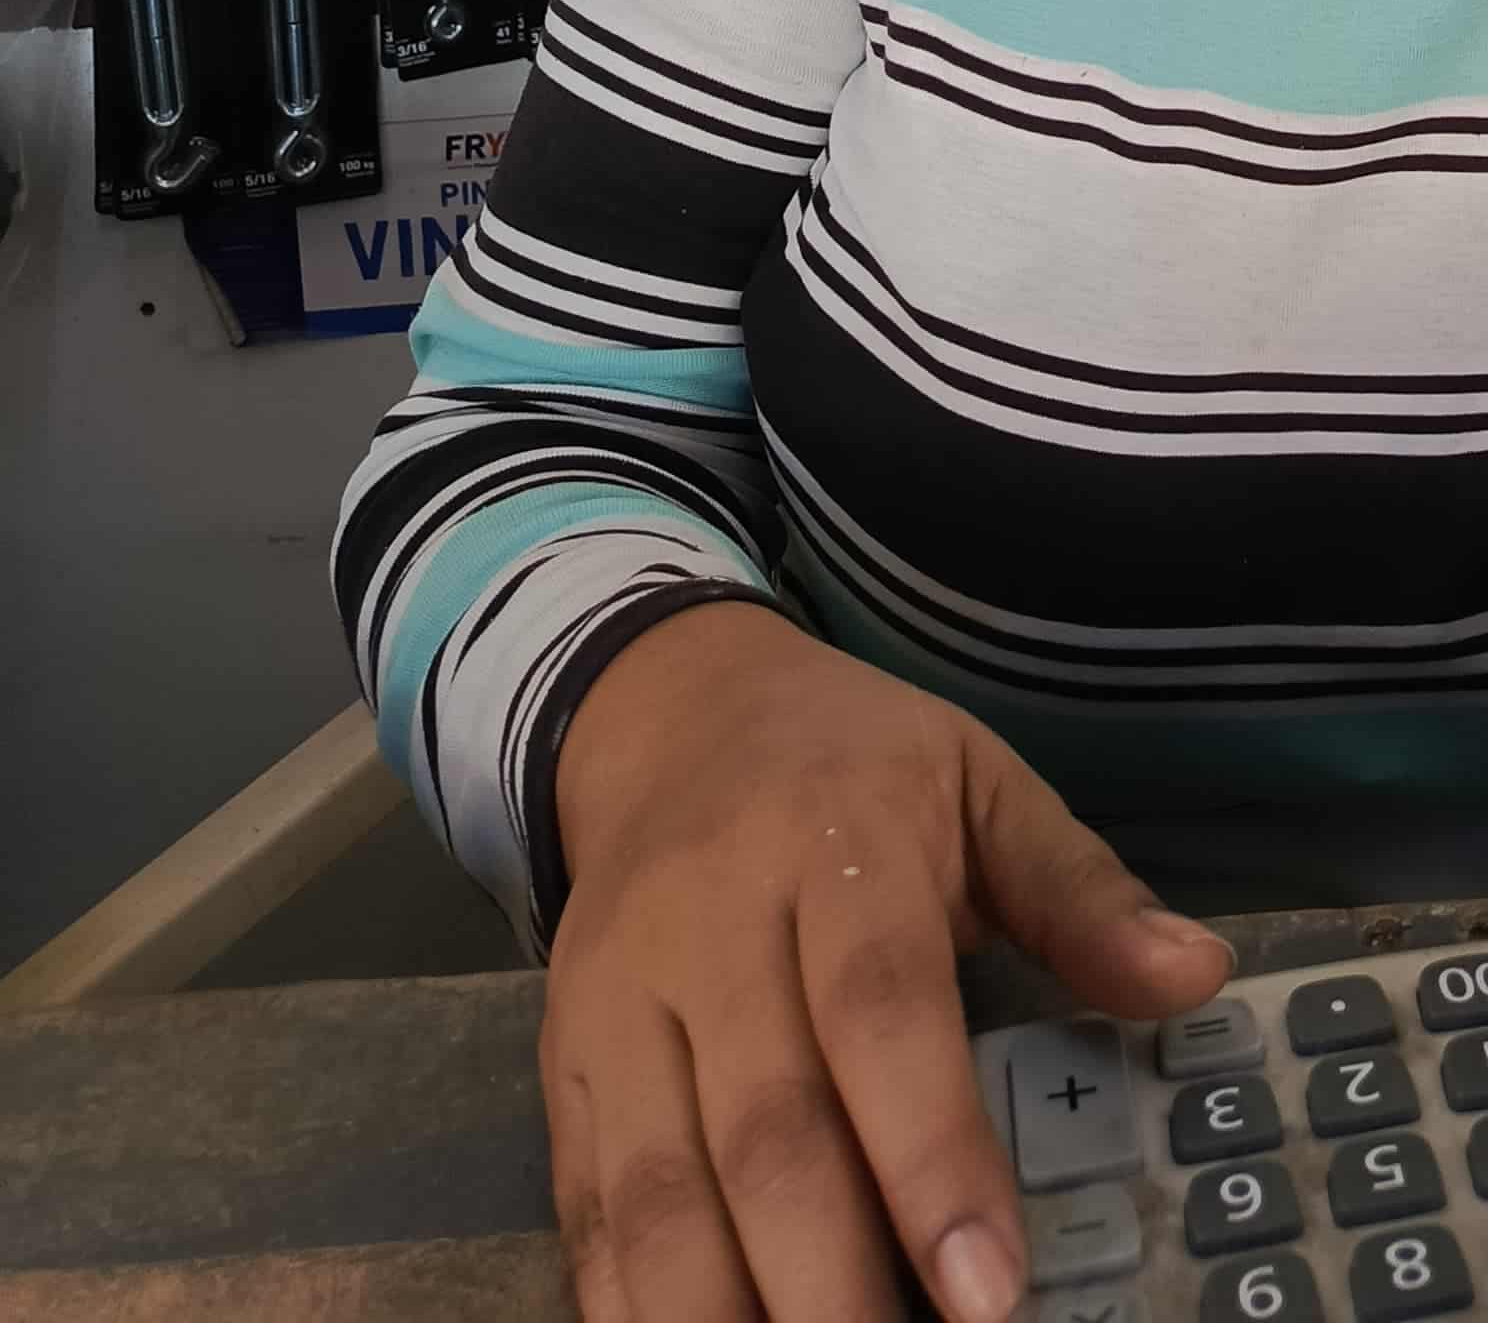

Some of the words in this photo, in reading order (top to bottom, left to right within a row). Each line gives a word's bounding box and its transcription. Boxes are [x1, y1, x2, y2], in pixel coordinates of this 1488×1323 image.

[1204, 1086, 1243, 1132] 3
[1338, 1061, 1381, 1104] 2
[1219, 1173, 1263, 1220] 6
[1362, 1144, 1405, 1191] 5
[1238, 1266, 1285, 1319] 9
[1384, 1241, 1430, 1288] 8
